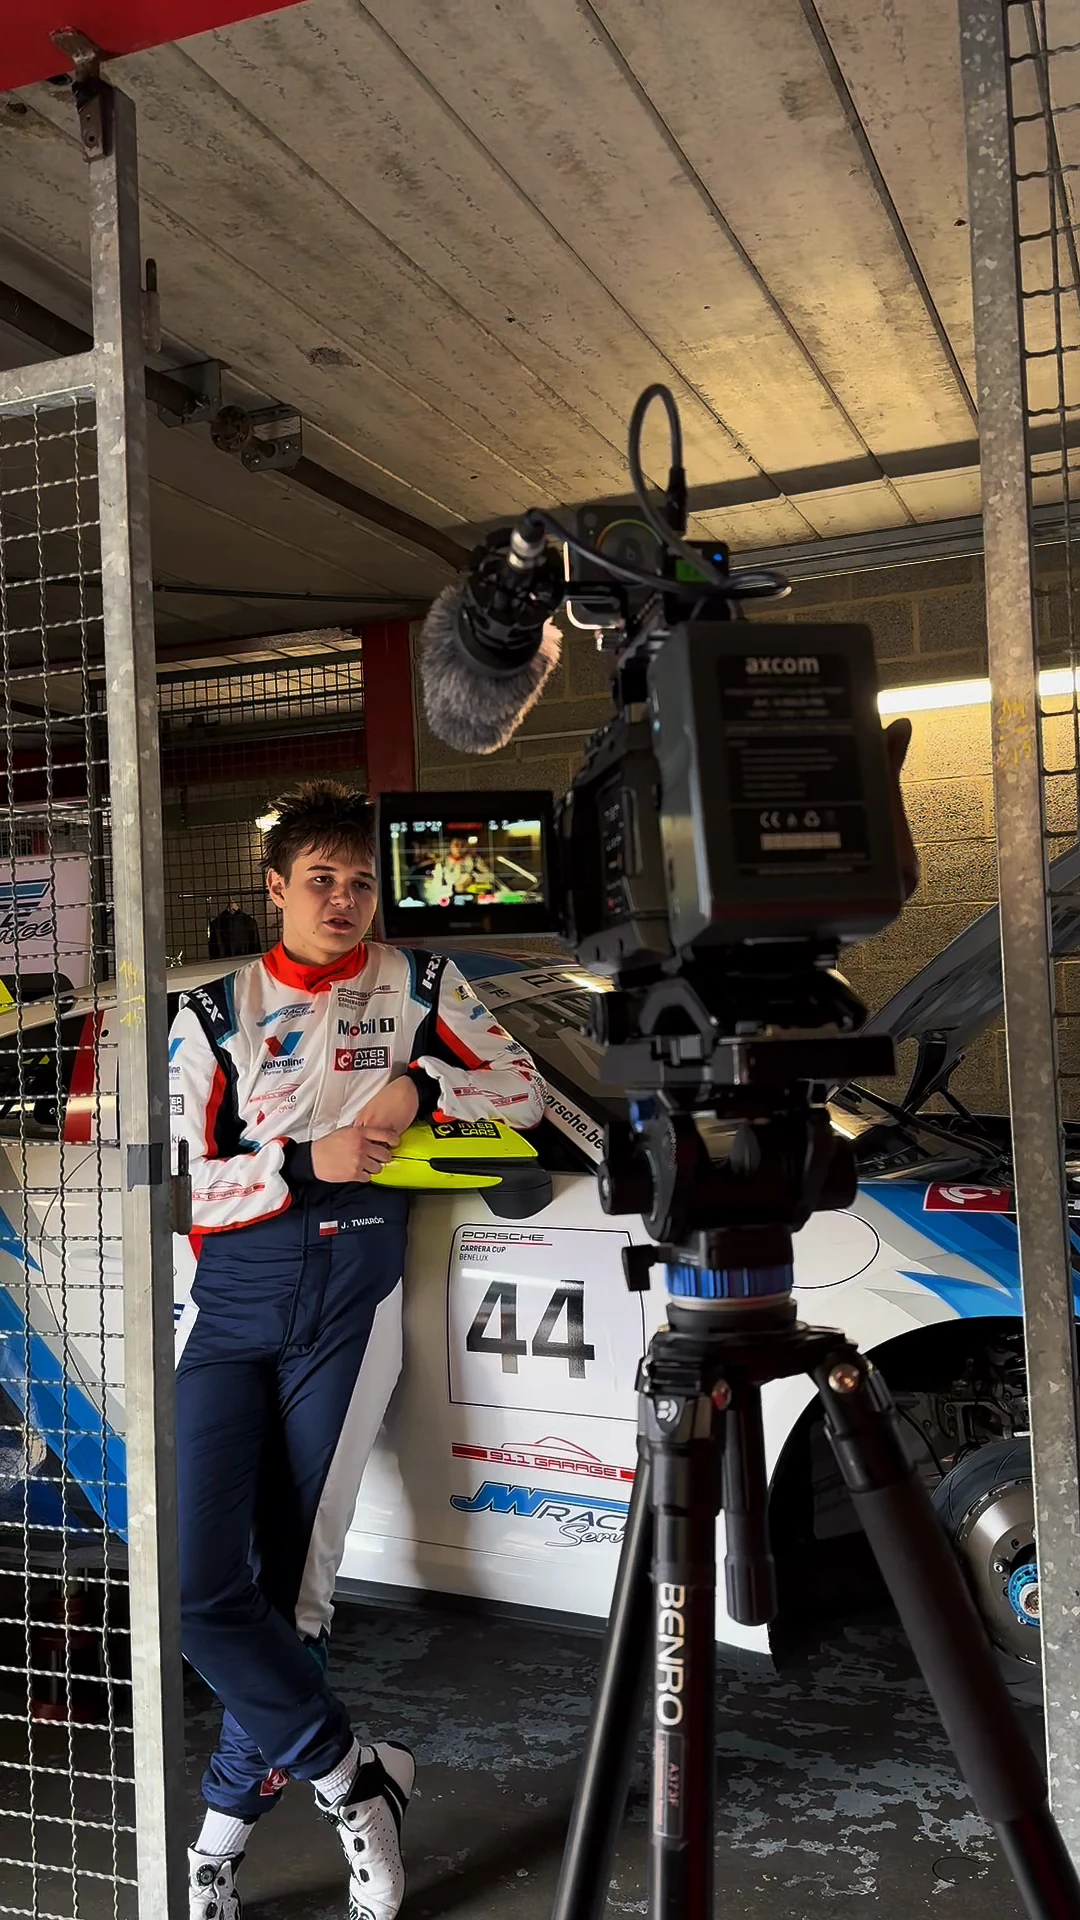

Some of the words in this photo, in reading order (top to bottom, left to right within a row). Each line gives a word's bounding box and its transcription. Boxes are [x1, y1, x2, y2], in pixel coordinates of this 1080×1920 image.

[744, 656, 820, 674] axcom
[192, 988, 225, 1023] HRX
[337, 1017, 376, 1037] Mobil
[261, 1056, 305, 1071] Valvoline
[353, 1057, 386, 1067] CARS
[460, 1128, 497, 1136] CARS
[340, 1221, 350, 1230] J.
[461, 1231, 545, 1242] PORSCHE
[459, 1253, 489, 1261] BENELUX
[460, 1245, 490, 1253] CARRERA
[466, 1279, 596, 1379] 44
[489, 1451, 531, 1465] 911
[533, 1457, 618, 1478] GARAGE
[537, 1503, 627, 1530] RAC
[544, 1522, 624, 1549] Serv
[656, 1582, 687, 1727] BENRO
